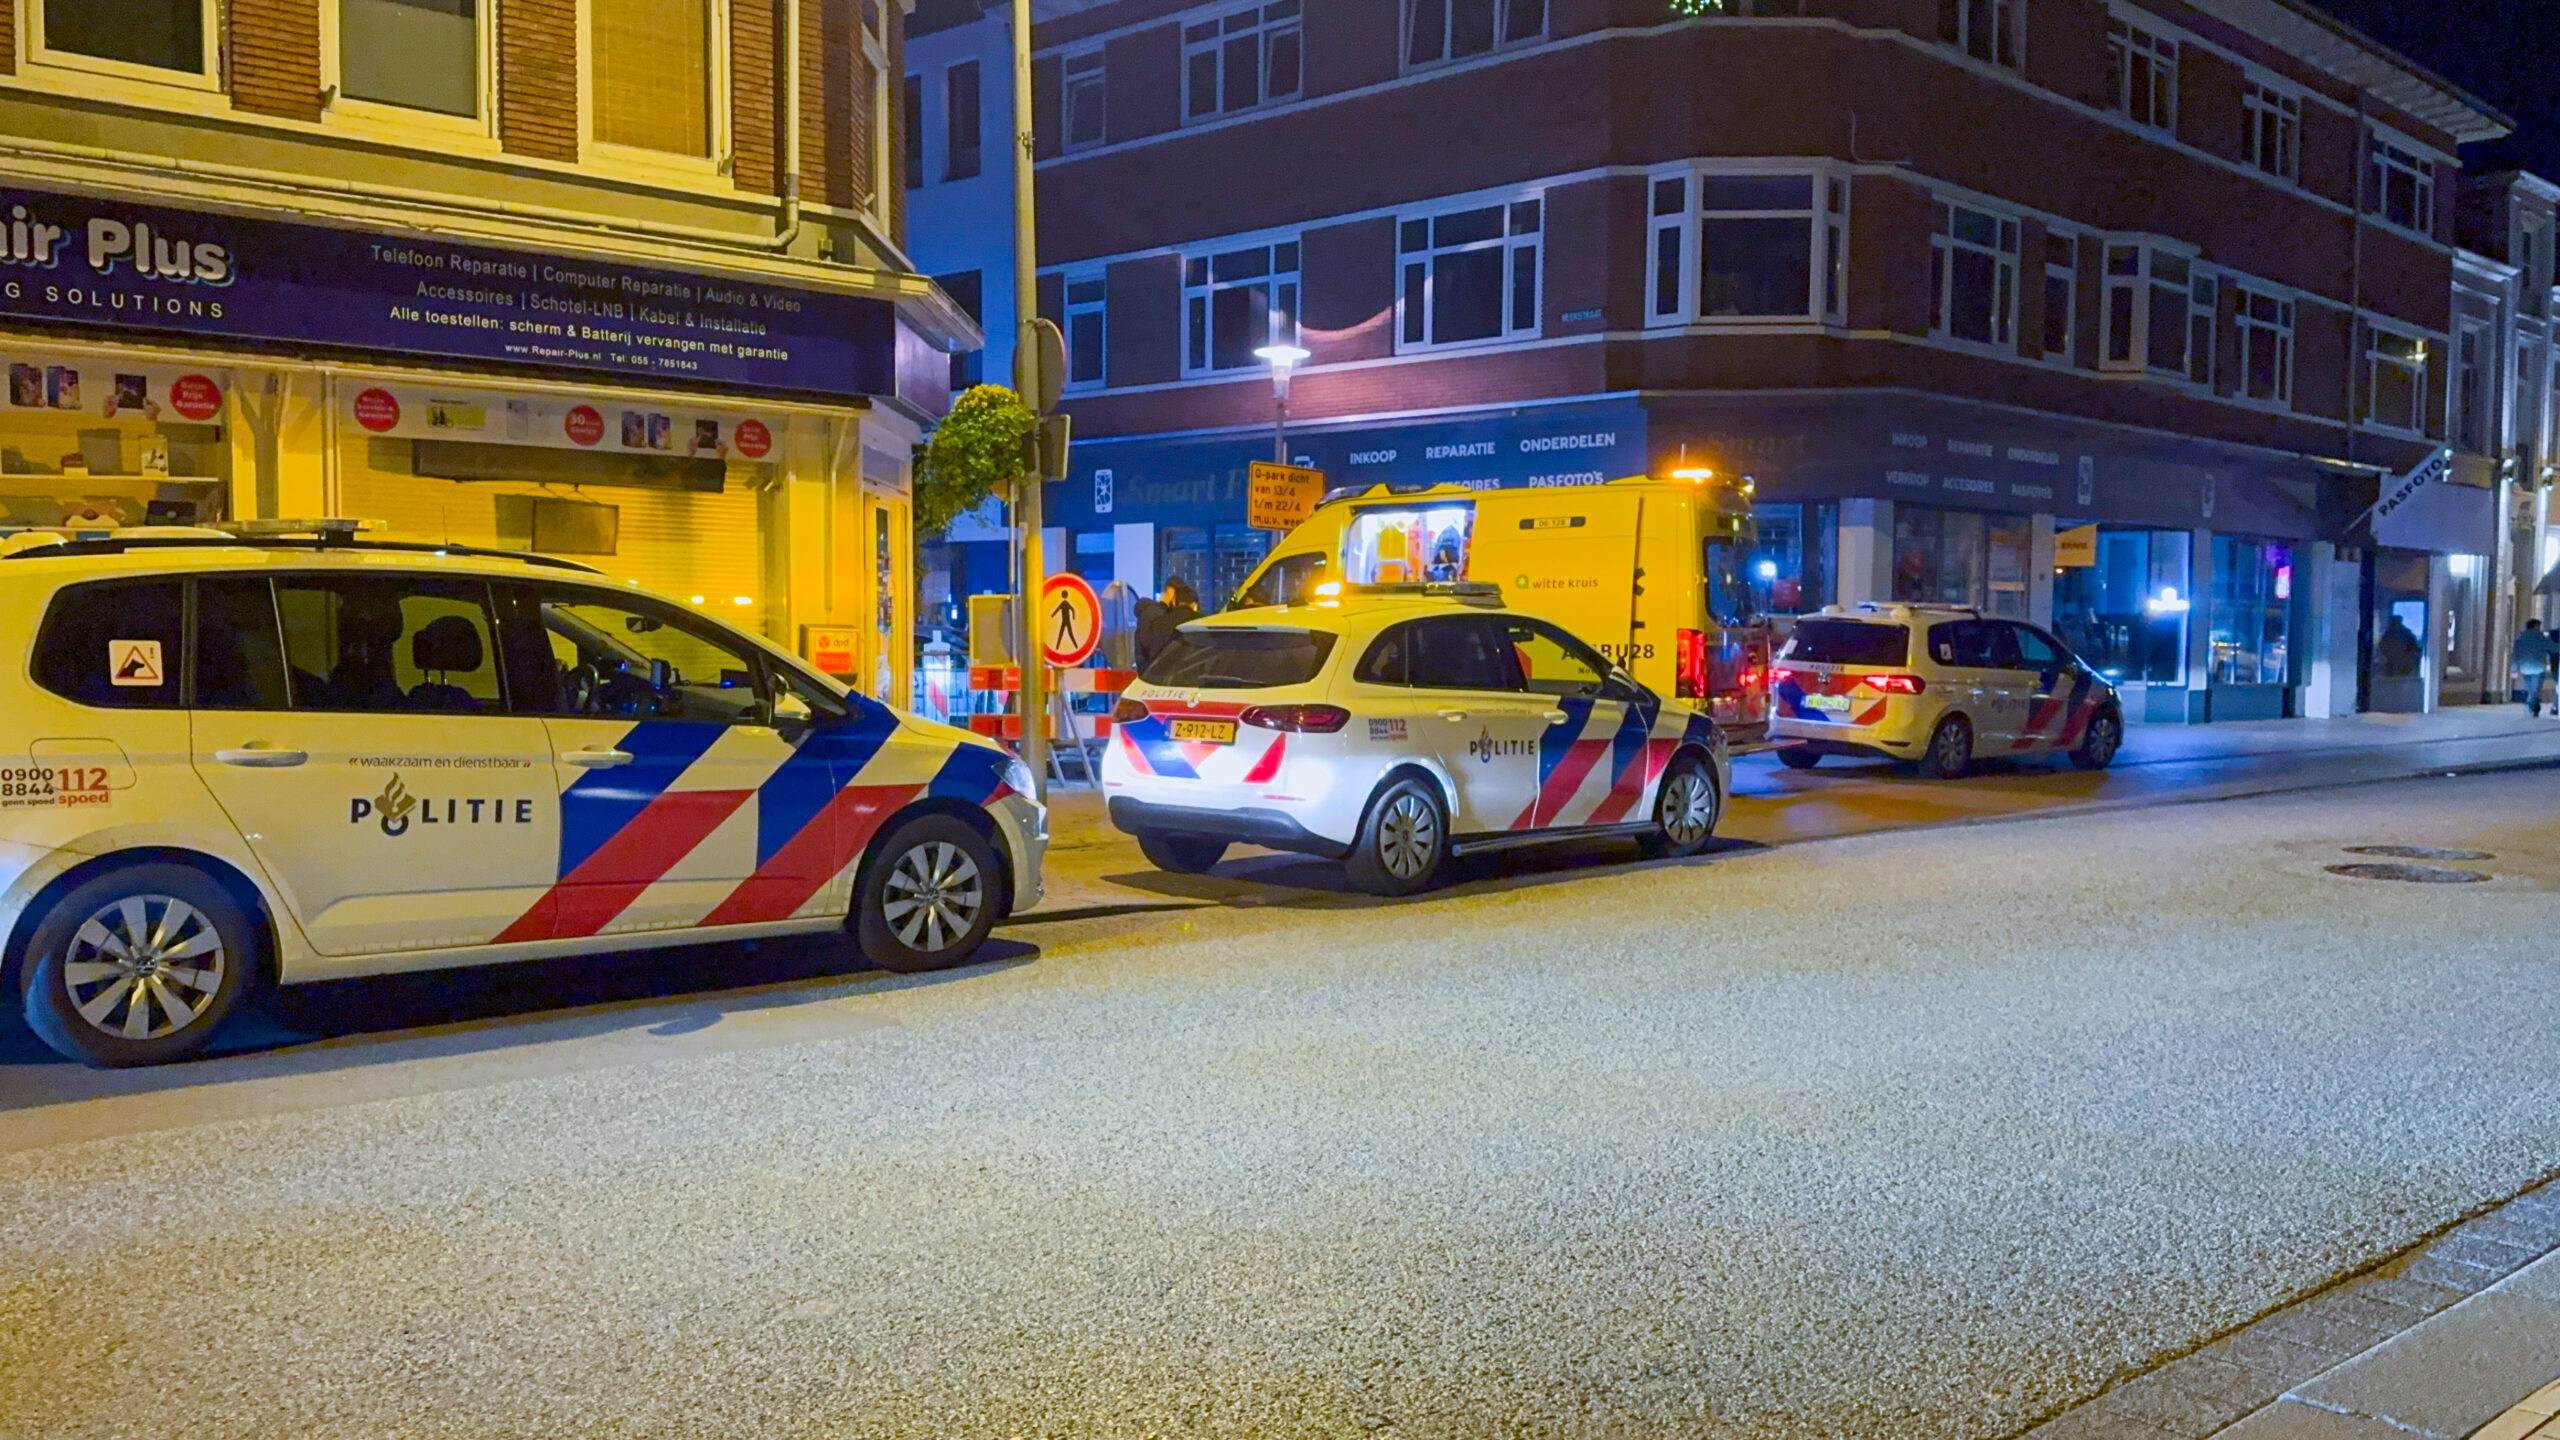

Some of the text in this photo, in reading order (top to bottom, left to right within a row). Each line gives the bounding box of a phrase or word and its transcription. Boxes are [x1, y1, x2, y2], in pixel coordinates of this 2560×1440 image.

[0, 206, 227, 280] ir Plus
[371, 245, 444, 268] Telefoon
[450, 254, 527, 278] Reparatie
[543, 266, 616, 289] Computer
[621, 275, 691, 299] Reparatie
[705, 287, 744, 305] Audio
[749, 293, 758, 307] &
[763, 294, 801, 313] Video
[46, 286, 223, 318] SOLUTIONS
[416, 281, 513, 306] Accessoires
[530, 294, 624, 319] Schotel-LNB
[639, 308, 680, 326] Kabel
[685, 311, 694, 327] &
[700, 313, 766, 336] Installatie
[390, 306, 788, 361] Alle toestellen: scherm & Batterij vervangen met garantie
[631, 355, 648, 365] 055
[1350, 433, 1616, 465] INKOOP REPARATIE ONDERDELEN
[1255, 467, 1310, 485] Q-park dicht
[1529, 470, 1604, 488] PASFOTO'S
[1886, 470, 1931, 486] VERKOOP
[1255, 485, 1295, 497] van 13/4
[2378, 458, 2443, 517] PASFOTO
[1254, 498, 1301, 512] t/m 22/4
[1532, 577, 1599, 589] witte kruis
[1142, 690, 1184, 698] POLITIE
[1175, 723, 1225, 739] Z-912-LZ
[1389, 719, 1407, 731] 112
[1470, 740, 1534, 763] POLITIE
[360, 757, 432, 767] waakzaam
[435, 757, 450, 767] en
[453, 756, 520, 768] dienstbaar
[1, 768, 54, 781] 0900
[57, 767, 108, 791] 112
[2, 783, 54, 796] 8844
[2, 798, 55, 807] geen spoed
[58, 792, 109, 807] spoed
[351, 798, 532, 836] POLITIE
